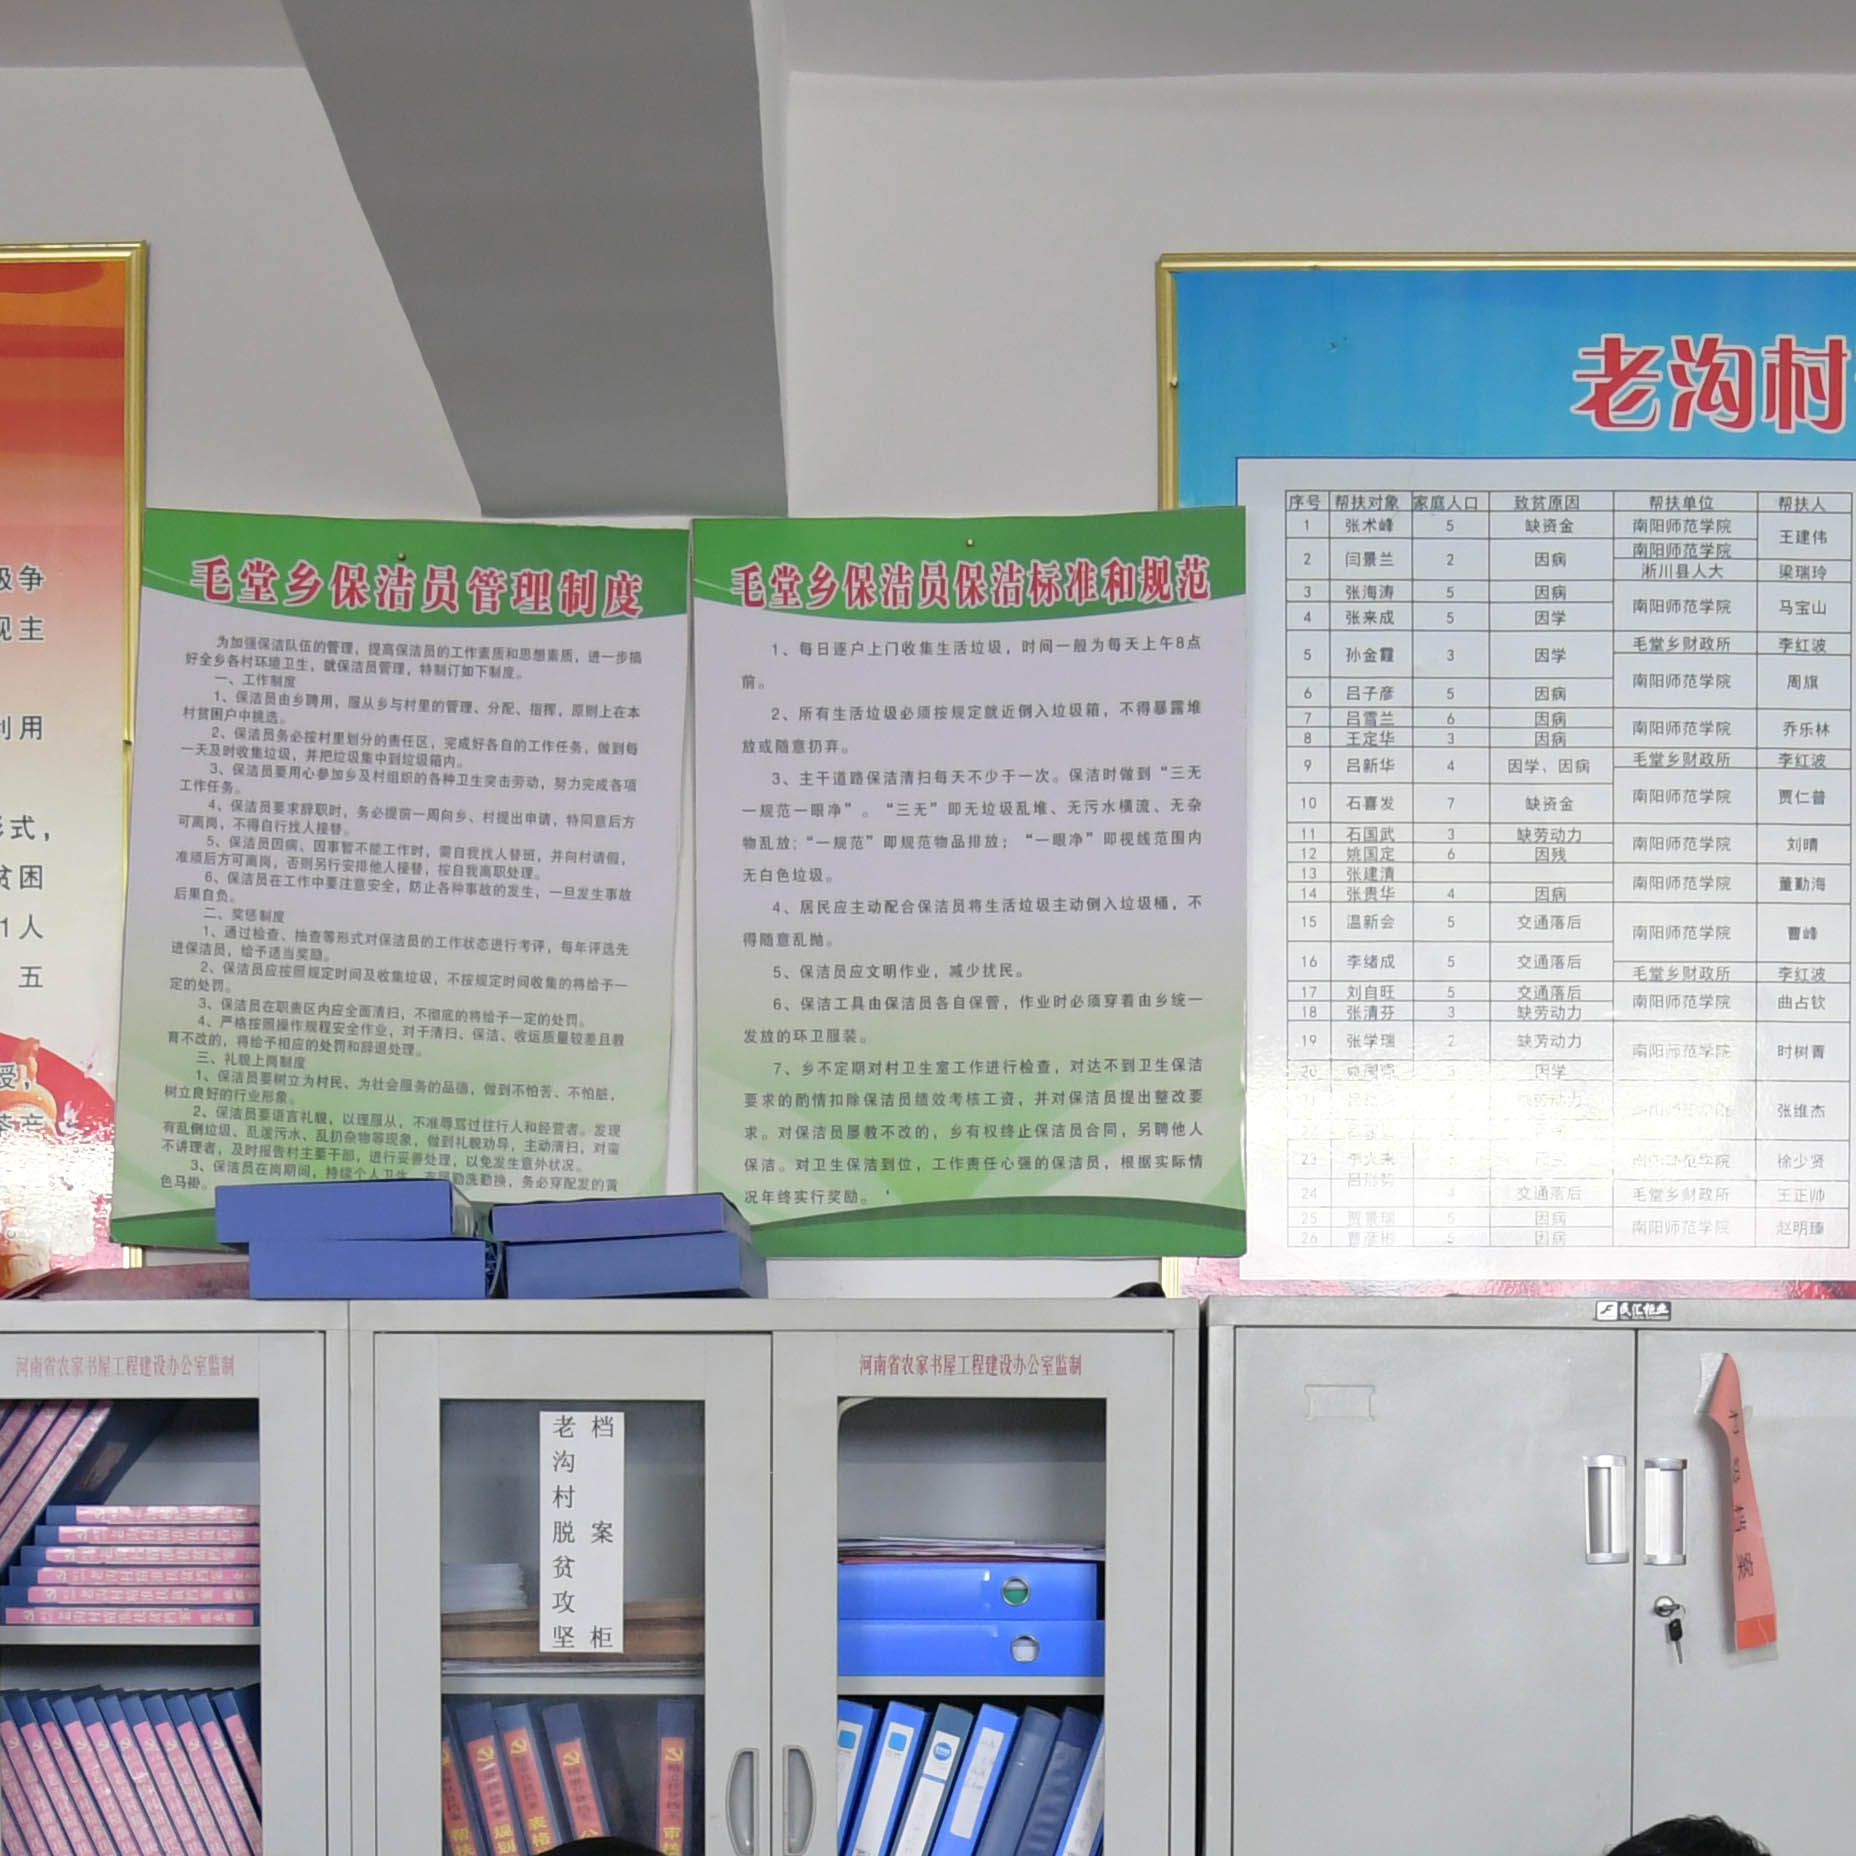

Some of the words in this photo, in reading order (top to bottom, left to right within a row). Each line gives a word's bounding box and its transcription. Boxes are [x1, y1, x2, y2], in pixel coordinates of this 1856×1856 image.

[1289, 495, 1320, 511] 序号
[1335, 495, 1400, 511] 帮扶对象
[1413, 495, 1479, 511] 家庭人口
[1514, 495, 1580, 512] 致贫原因
[1649, 495, 1714, 511] 帮扶单位
[1778, 495, 1825, 512] 帮扶人
[1525, 518, 1574, 535] 缺资金
[1632, 518, 1732, 535] 南阳师范学院
[1780, 529, 1828, 545] 王建伟
[1304, 553, 1311, 566] 2
[1534, 552, 1566, 568] 因病
[1641, 562, 1724, 579] 淅川县人大
[190, 554, 644, 619] 毛堂乡保洁员管理制度
[730, 554, 1211, 609] 毛堂乡保洁员保洁标准和规范
[1632, 636, 1731, 653] 毛堂乡财政所
[1778, 637, 1826, 653] 李红波
[215, 675, 296, 689] 一、工作制度
[742, 674, 765, 691] 前。
[743, 867, 833, 883] 无白色垃圾。
[15, 1354, 235, 1378] 河南省农家书屋工程建设办公室监制
[858, 1353, 1083, 1377] 河南省农家书屋工程建设办公室监制
[552, 1415, 576, 1649] 老沟村脱贫攻坚
